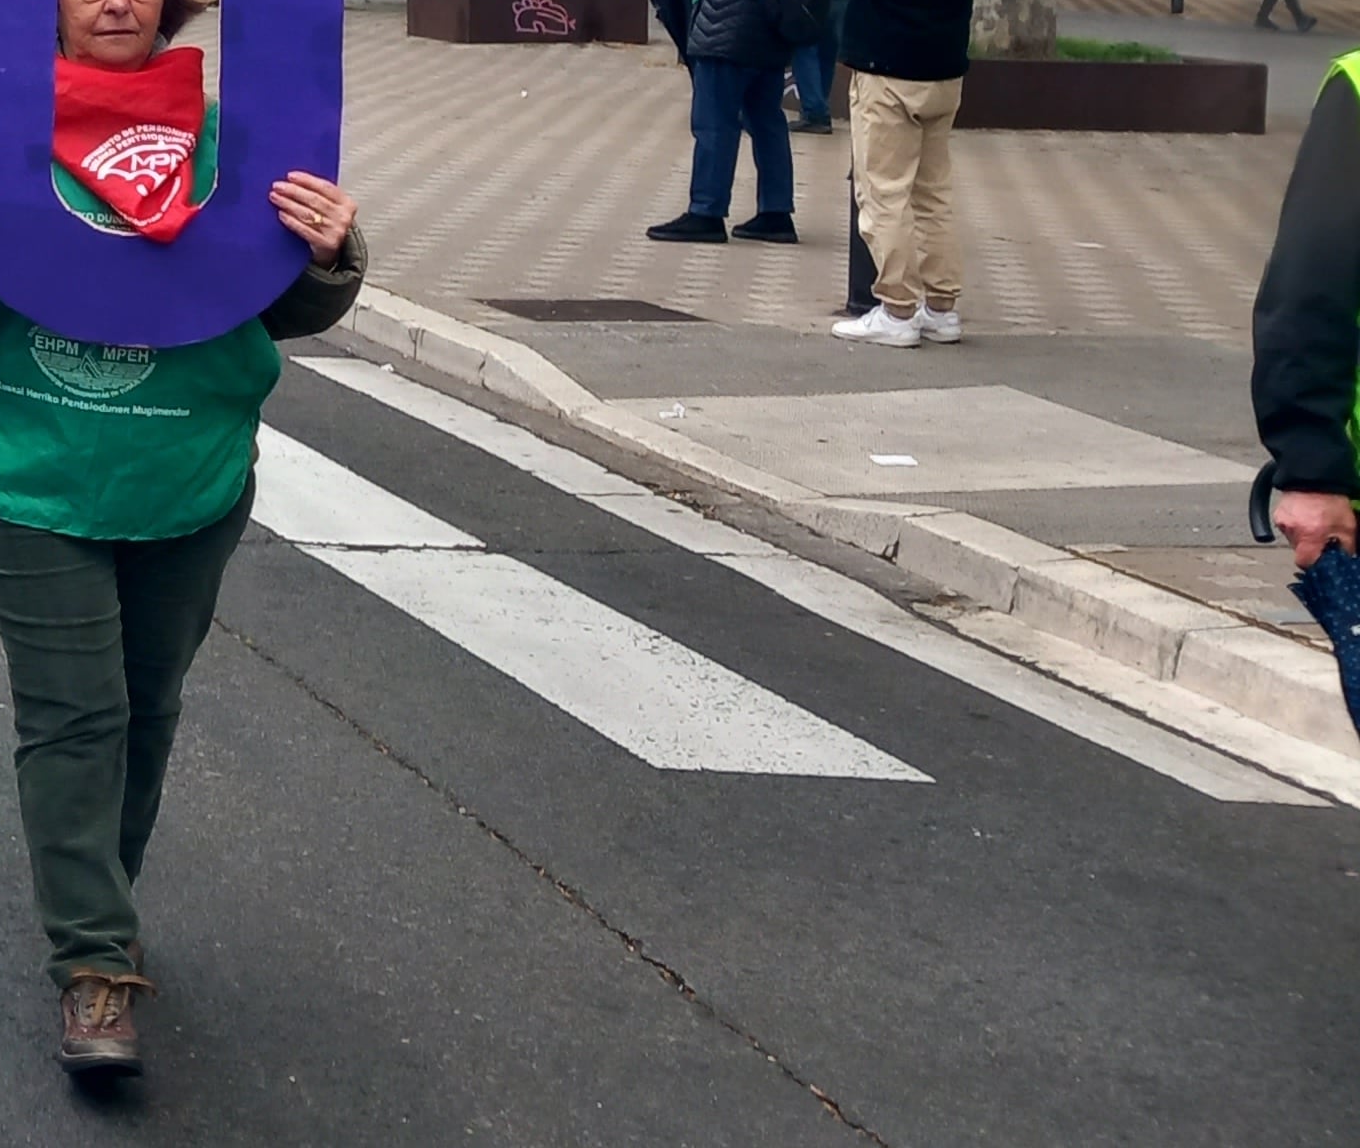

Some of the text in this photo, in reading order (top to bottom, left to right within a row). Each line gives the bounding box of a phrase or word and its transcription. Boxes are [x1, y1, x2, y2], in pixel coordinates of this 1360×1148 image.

[34, 334, 150, 364] EHPM MPEH
[26, 387, 59, 404] Herriko
